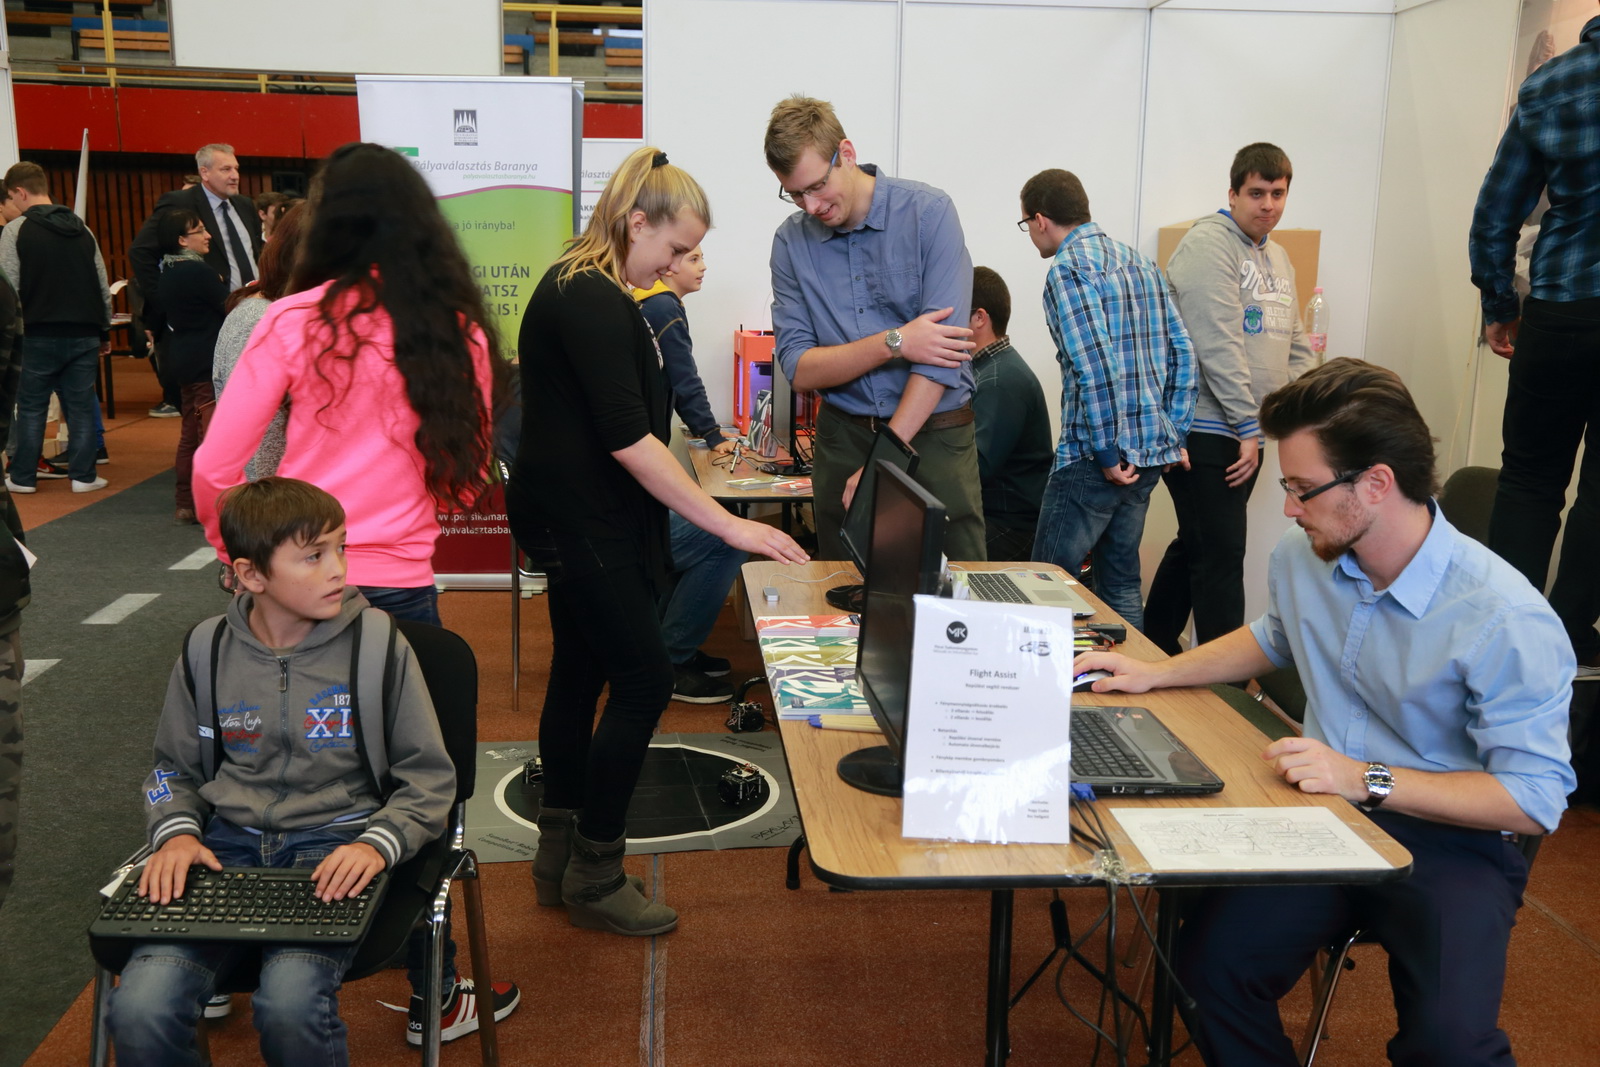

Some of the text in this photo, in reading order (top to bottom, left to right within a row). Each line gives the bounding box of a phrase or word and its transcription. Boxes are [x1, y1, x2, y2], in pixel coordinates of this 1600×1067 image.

[413, 160, 538, 173] Pályaválasztás Baranya
[462, 221, 471, 231] jó
[475, 221, 515, 232] irányba!
[473, 263, 530, 278] GI UTÁN
[483, 285, 518, 297] ATSZ
[970, 669, 1017, 679] Flight Assist
